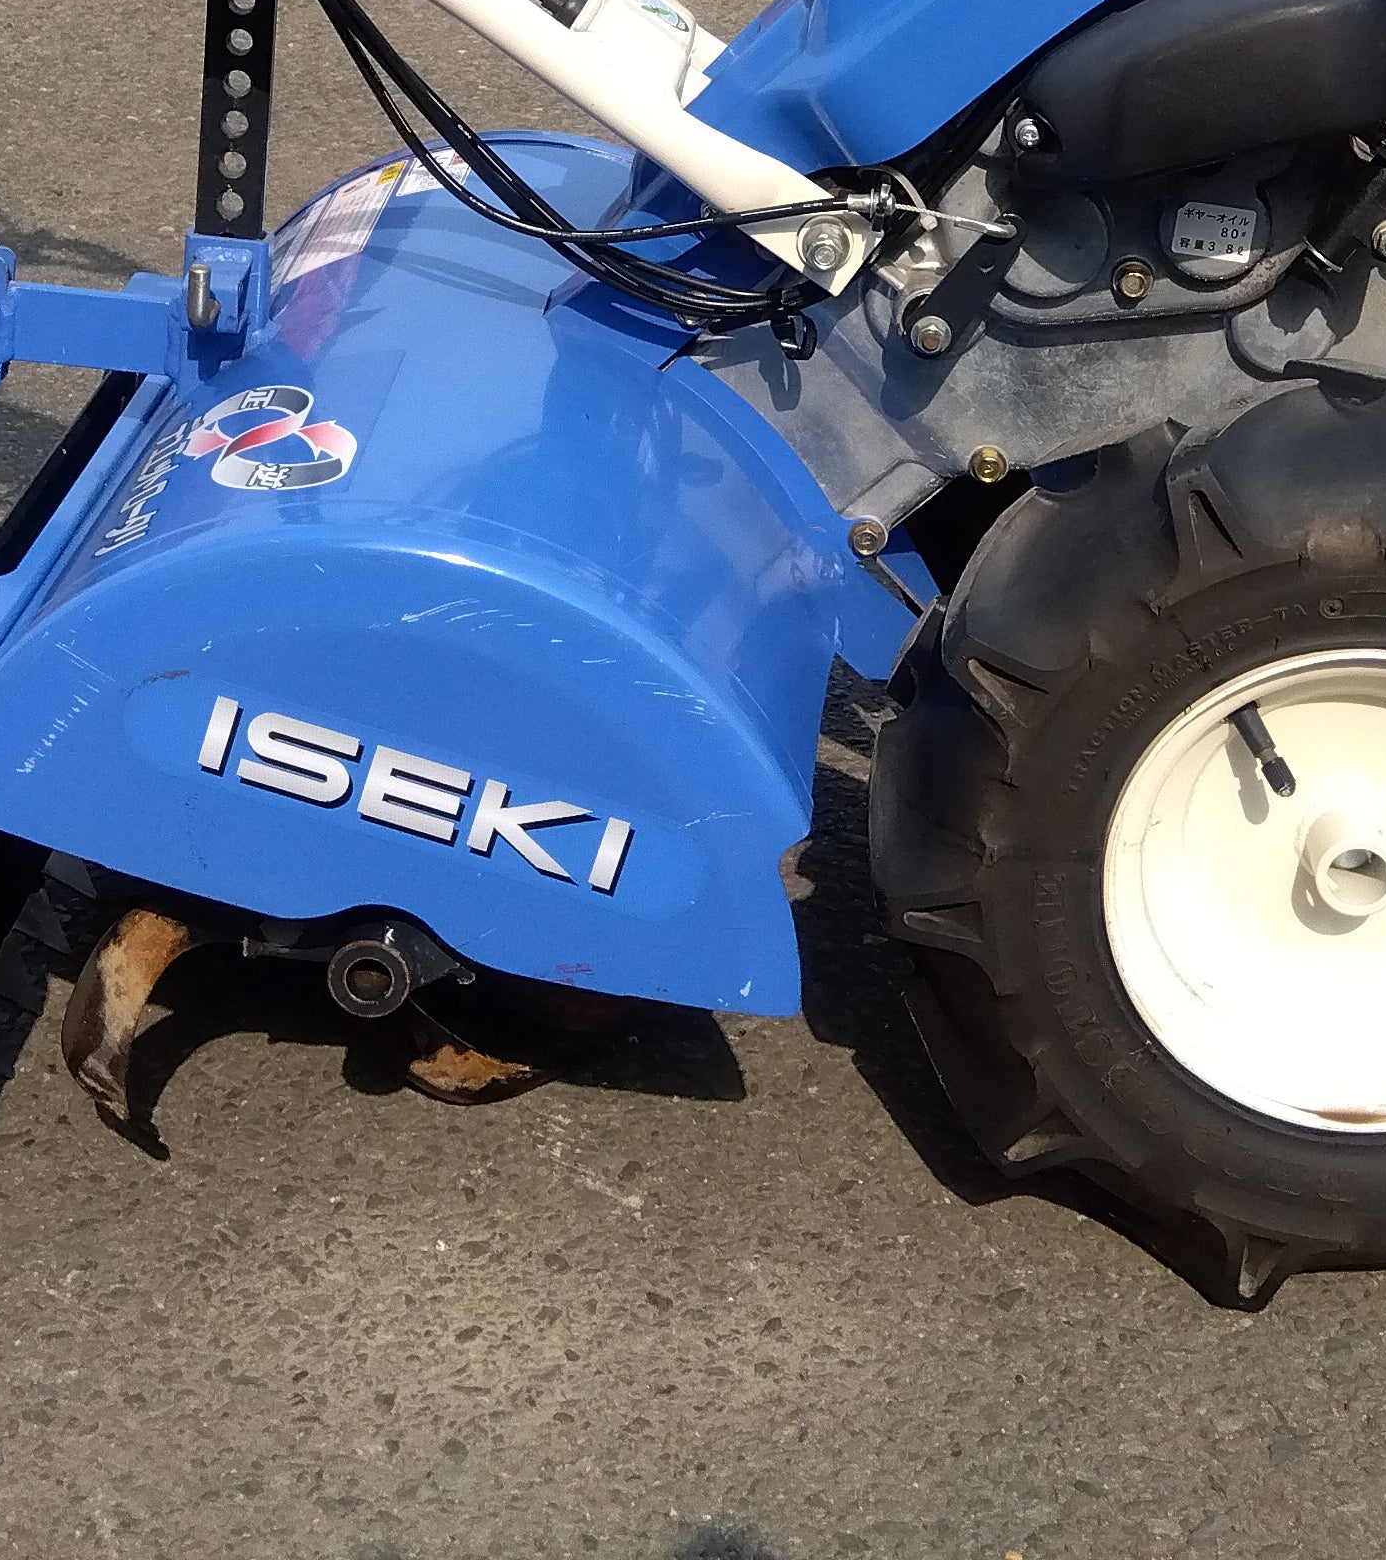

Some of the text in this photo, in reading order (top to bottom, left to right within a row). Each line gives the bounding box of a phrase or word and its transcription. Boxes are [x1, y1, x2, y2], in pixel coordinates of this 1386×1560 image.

[1182, 207, 1250, 227] ギヤーオイル
[197, 695, 635, 896] ISEKI
